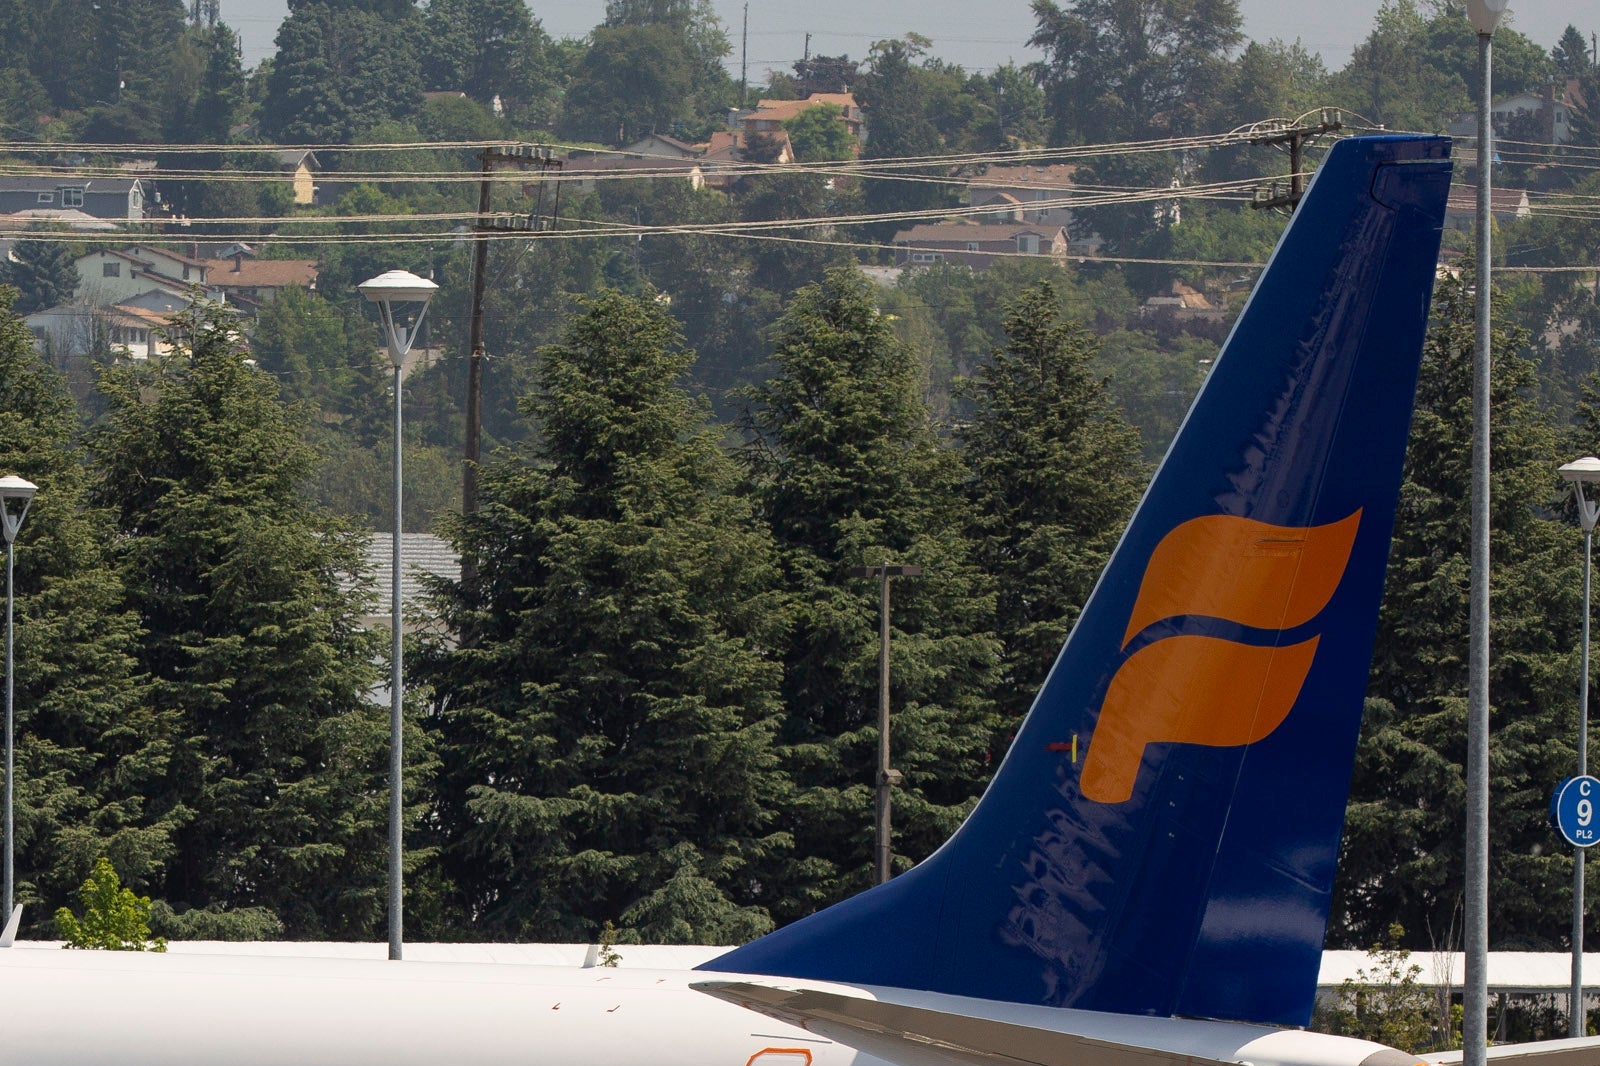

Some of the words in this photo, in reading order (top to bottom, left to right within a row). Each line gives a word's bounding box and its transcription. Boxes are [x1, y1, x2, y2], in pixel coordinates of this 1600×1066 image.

[1579, 780, 1592, 797] C
[1576, 799, 1593, 827] 9
[1576, 829, 1593, 839] PL2
